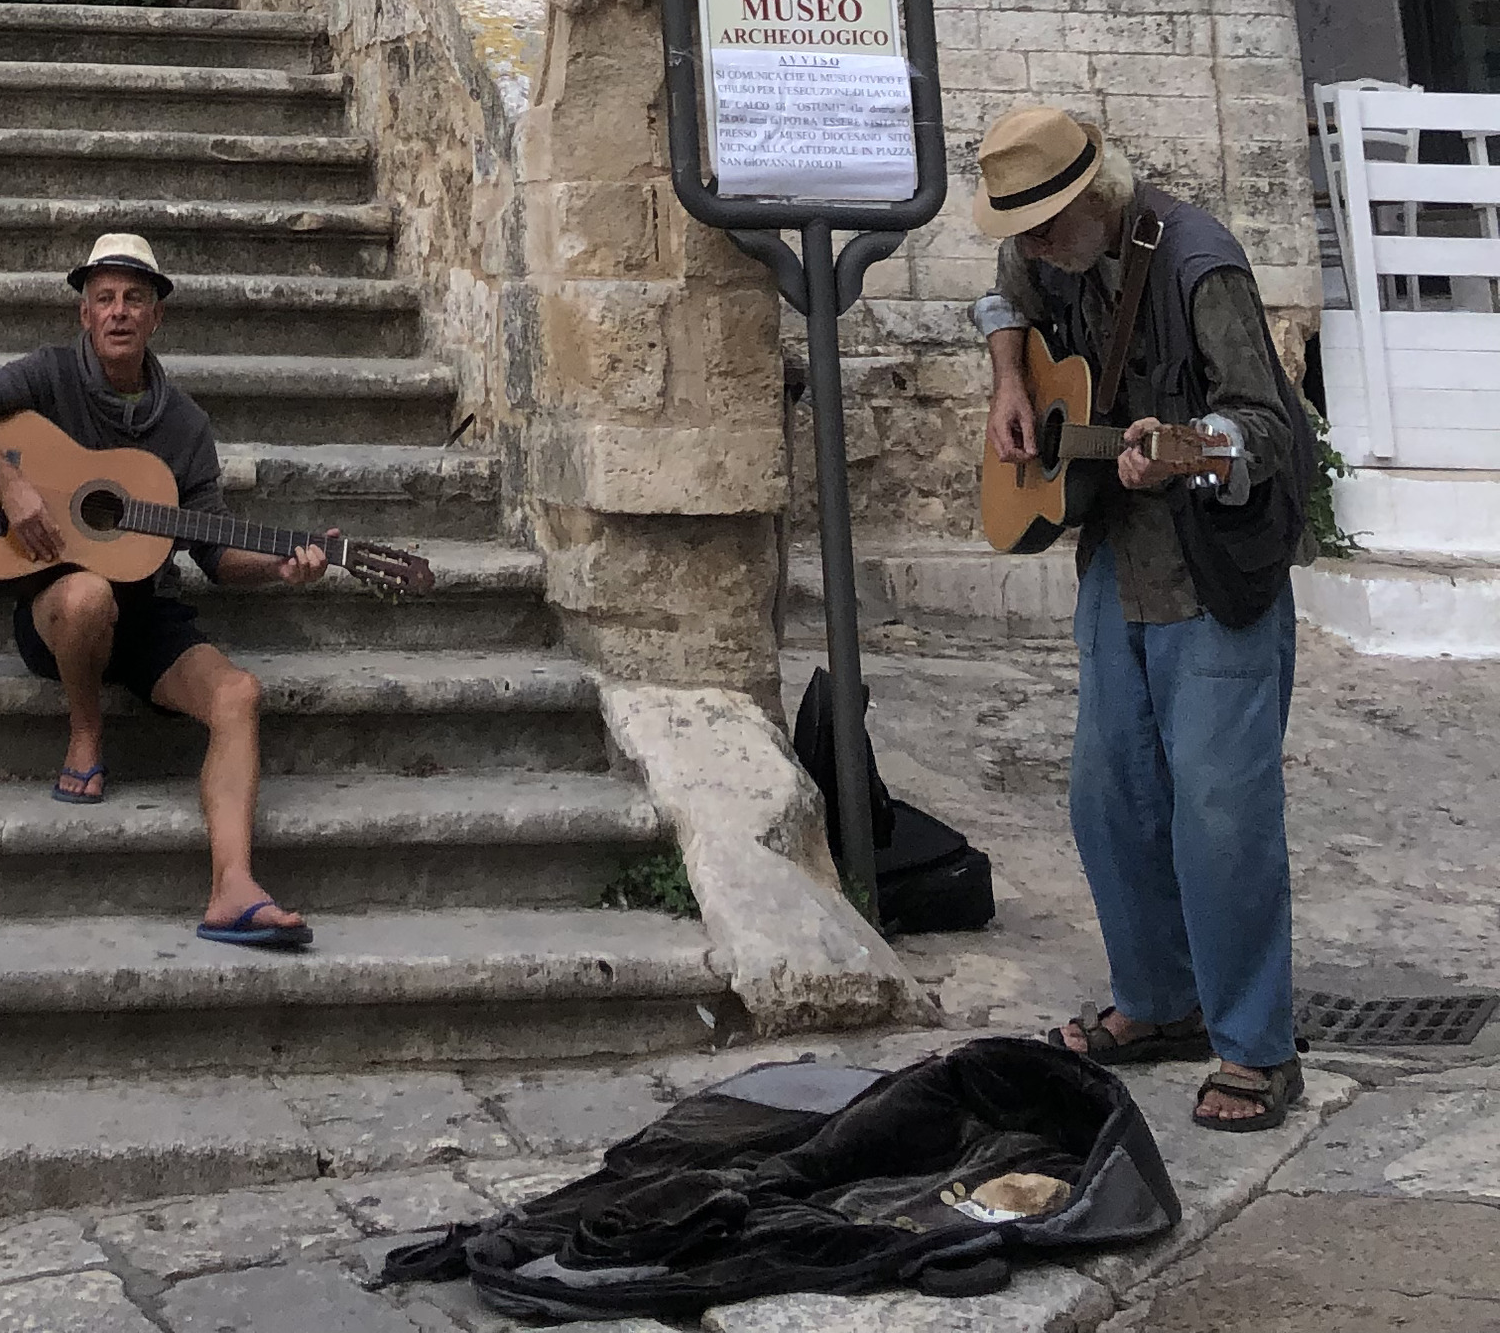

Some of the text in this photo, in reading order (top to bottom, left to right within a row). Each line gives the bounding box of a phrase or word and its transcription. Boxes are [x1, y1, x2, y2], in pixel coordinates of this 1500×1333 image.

[719, 28, 889, 46] ARCHEOLOGICO
[779, 55, 840, 66] AVVISO
[716, 70, 725, 79] SI
[727, 70, 783, 81] COMUNICA
[784, 72, 805, 81] CHE
[807, 73, 818, 82] IL
[820, 73, 857, 83] MUSEO
[859, 75, 895, 84] CIVICO
[717, 84, 755, 94] CHIUSO
[757, 86, 776, 94] PER
[778, 86, 851, 96] L'ESECUZIONE
[853, 88, 865, 96] DI
[719, 100, 730, 109] IL
[735, 101, 770, 110] CALCO
[775, 102, 786, 111] DI
[822, 117, 860, 127] ESSERE
[863, 118, 910, 128] VISITATO
[719, 129, 911, 142] PRESSO IL MUSEO DIOCESANO SITO
[719, 142, 912, 156] VICINO ALLA CATTEDRALE IN PIAZZA
[719, 156, 741, 166] SAN
[743, 158, 796, 167] GIOVANNI
[798, 159, 833, 169] PAOLO
